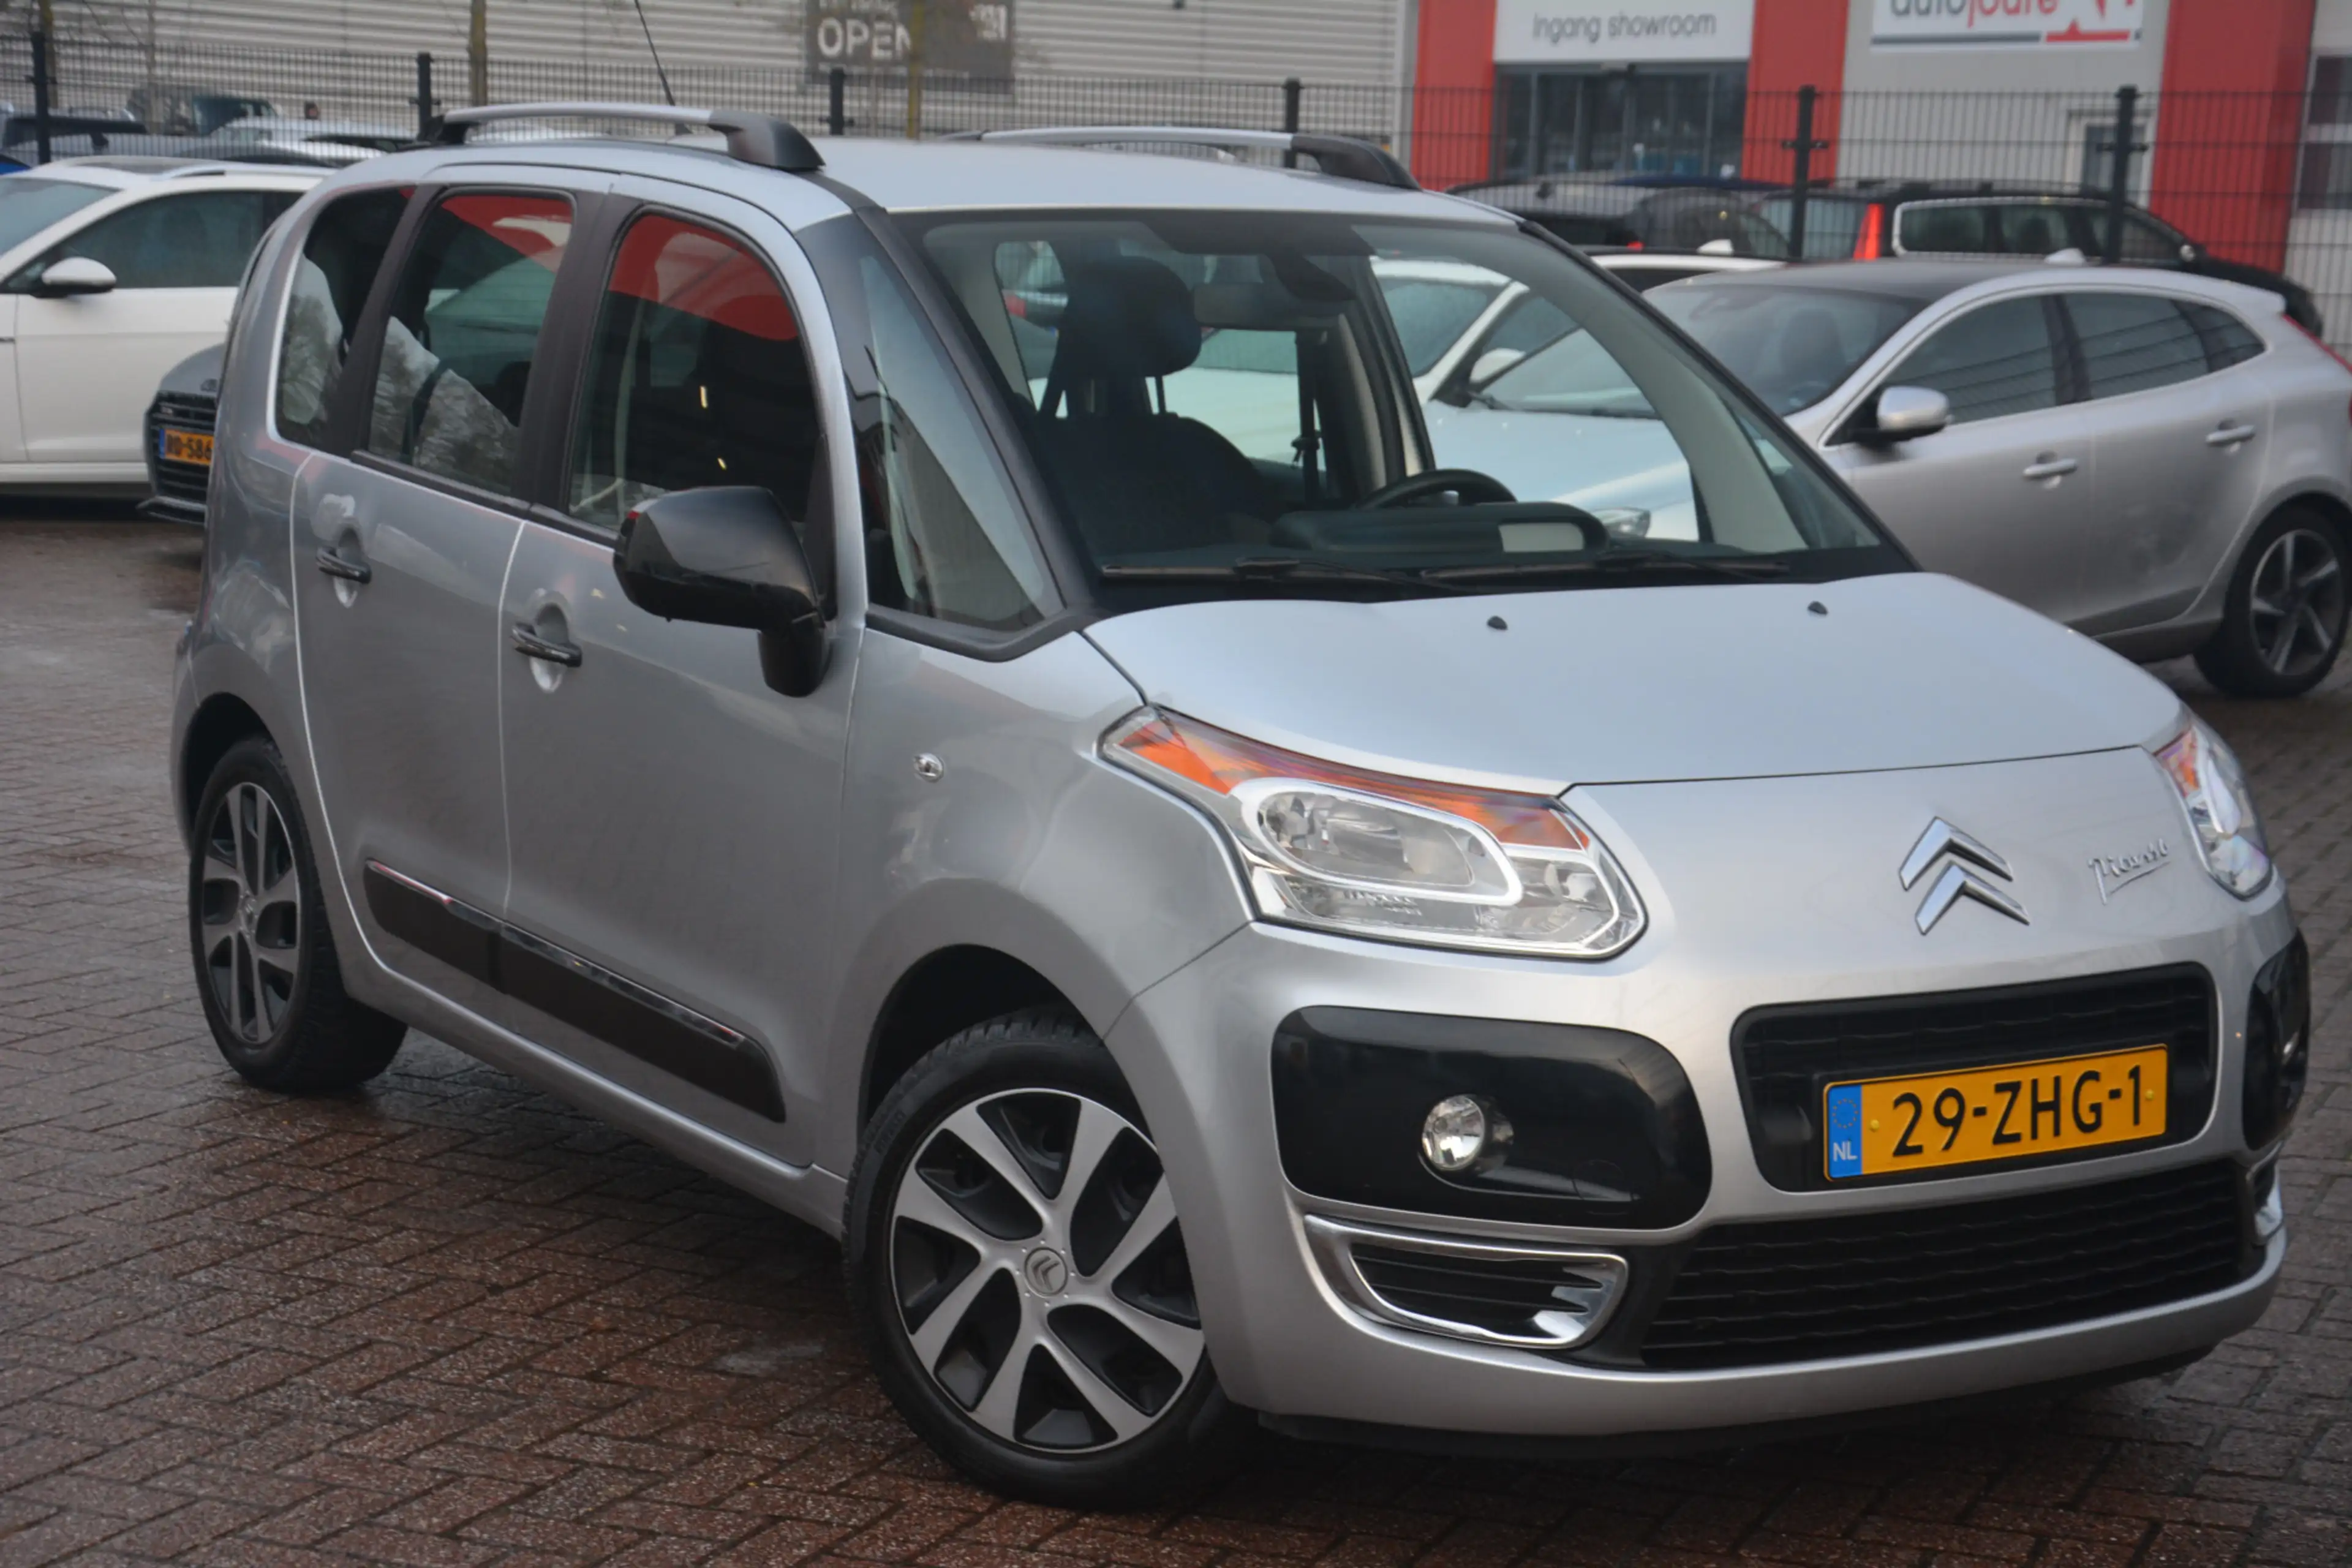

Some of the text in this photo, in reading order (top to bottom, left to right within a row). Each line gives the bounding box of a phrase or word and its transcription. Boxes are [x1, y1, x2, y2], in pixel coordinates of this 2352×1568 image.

[1607, 10, 1717, 37] showroom
[1893, 1065, 2141, 1158] 29-ZHG-1
[1833, 1142, 1858, 1162] NL
